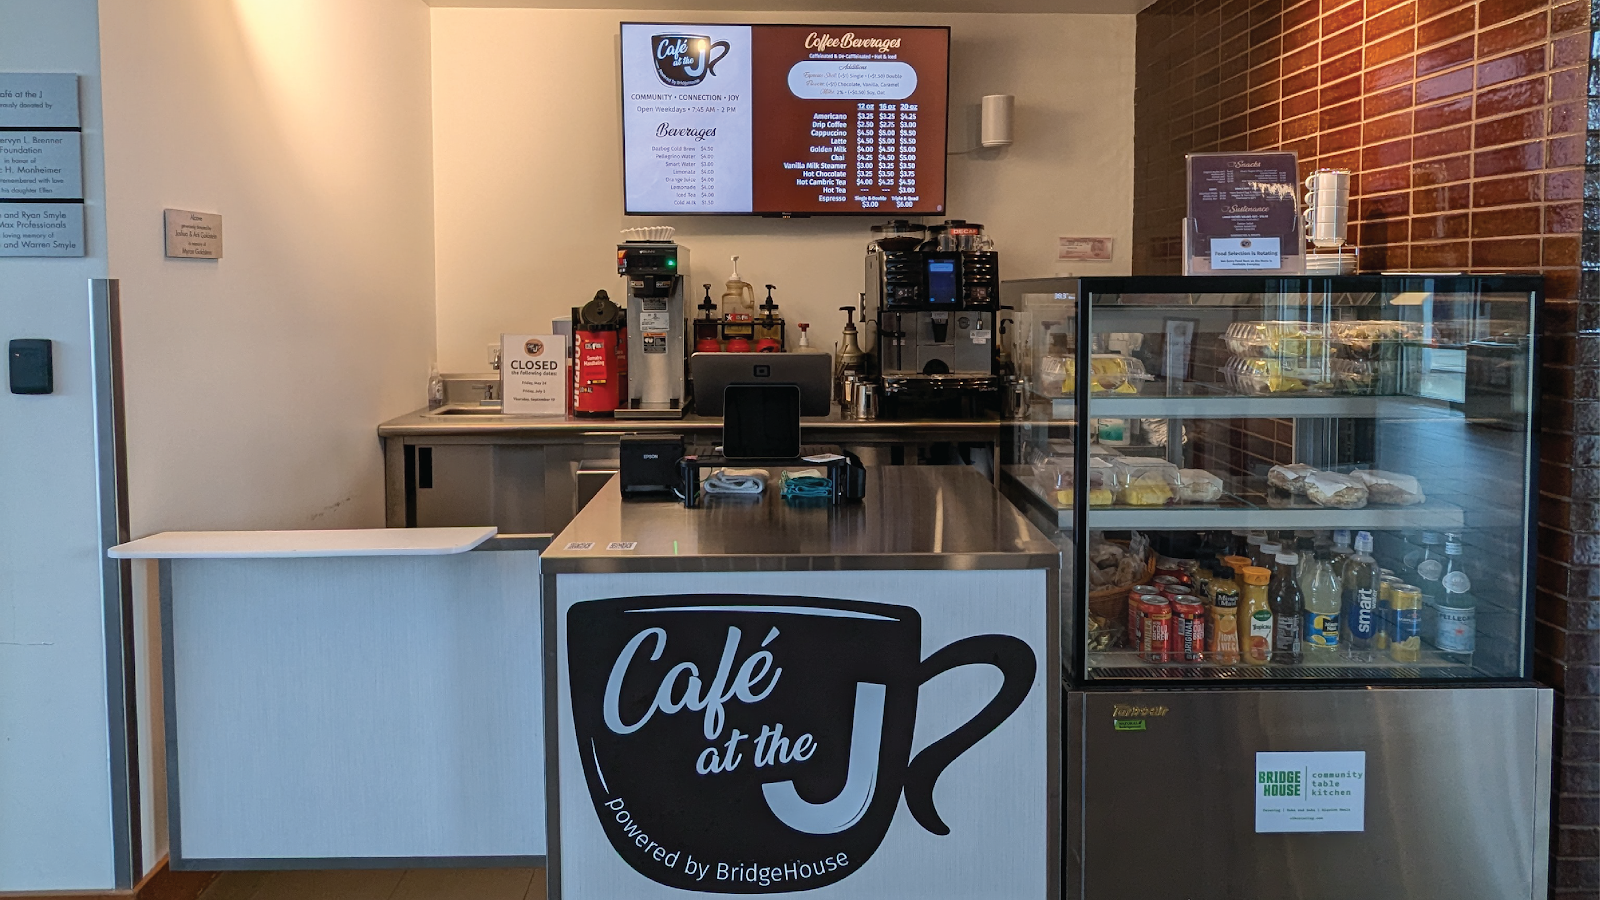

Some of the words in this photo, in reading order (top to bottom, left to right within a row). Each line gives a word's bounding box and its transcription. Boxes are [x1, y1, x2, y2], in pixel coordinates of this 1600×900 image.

[805, 32, 840, 51] Coffee
[840, 32, 901, 53] Beverages
[657, 39, 688, 60] Café
[673, 58, 682, 66] at
[682, 56, 694, 65] the
[684, 40, 706, 77] J
[0, 90, 12, 98] afé
[656, 122, 716, 142] Beverages
[18, 166, 62, 174] Monheimer
[22, 210, 40, 220] Ryan
[44, 210, 66, 220] Smyle
[1229, 205, 1270, 213] Sustenance
[17, 220, 66, 228] Professionals
[4, 240, 19, 248] and
[52, 240, 76, 250] Smyle
[510, 360, 558, 370] CLOSED
[1359, 588, 1372, 632] smart
[603, 626, 782, 740] Café
[696, 729, 748, 774] at
[754, 723, 818, 768] the
[762, 682, 886, 835] J
[1258, 771, 1301, 783] BRIDGE
[1312, 771, 1363, 779] community
[1264, 784, 1300, 796] HOUSE
[604, 798, 680, 868] powered
[684, 856, 710, 881] by
[716, 852, 849, 886] BridgeHouse
